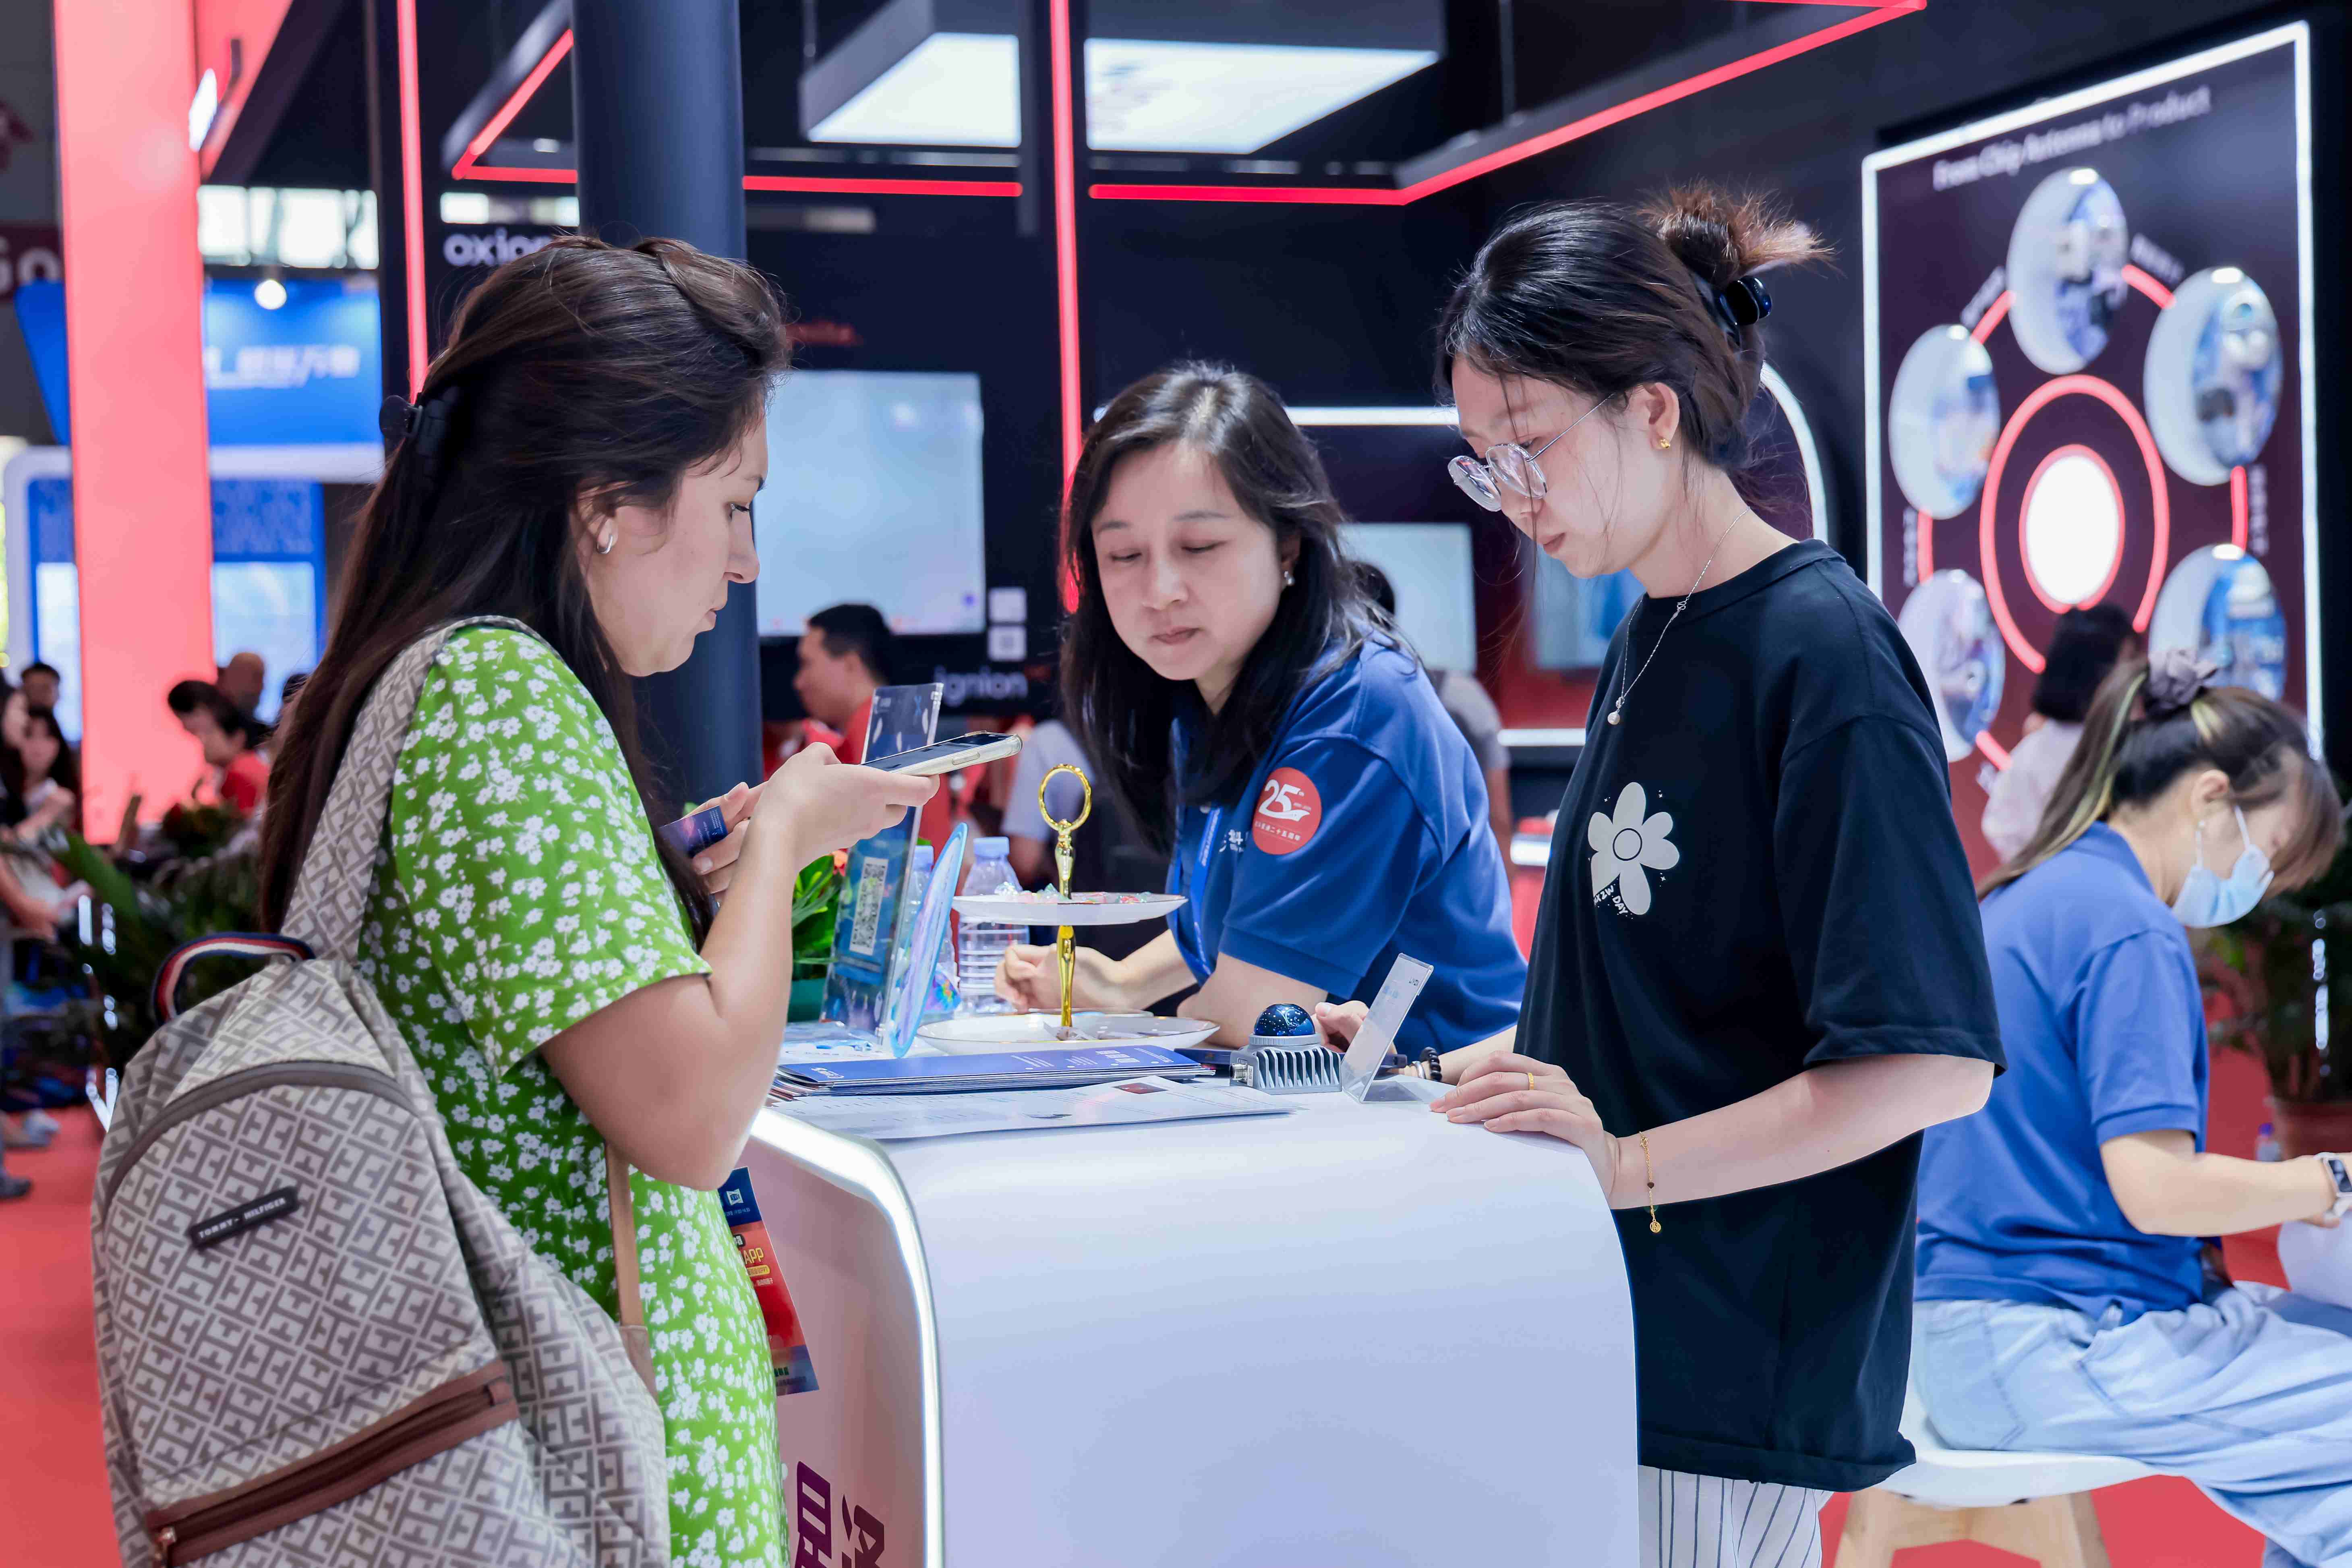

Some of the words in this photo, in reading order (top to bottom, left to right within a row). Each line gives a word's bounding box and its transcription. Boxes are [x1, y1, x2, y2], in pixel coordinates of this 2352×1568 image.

[1612, 895, 1628, 914] DAY
[199, 1218, 233, 1239] TOMMY
[244, 1197, 286, 1220] HILFIGER
